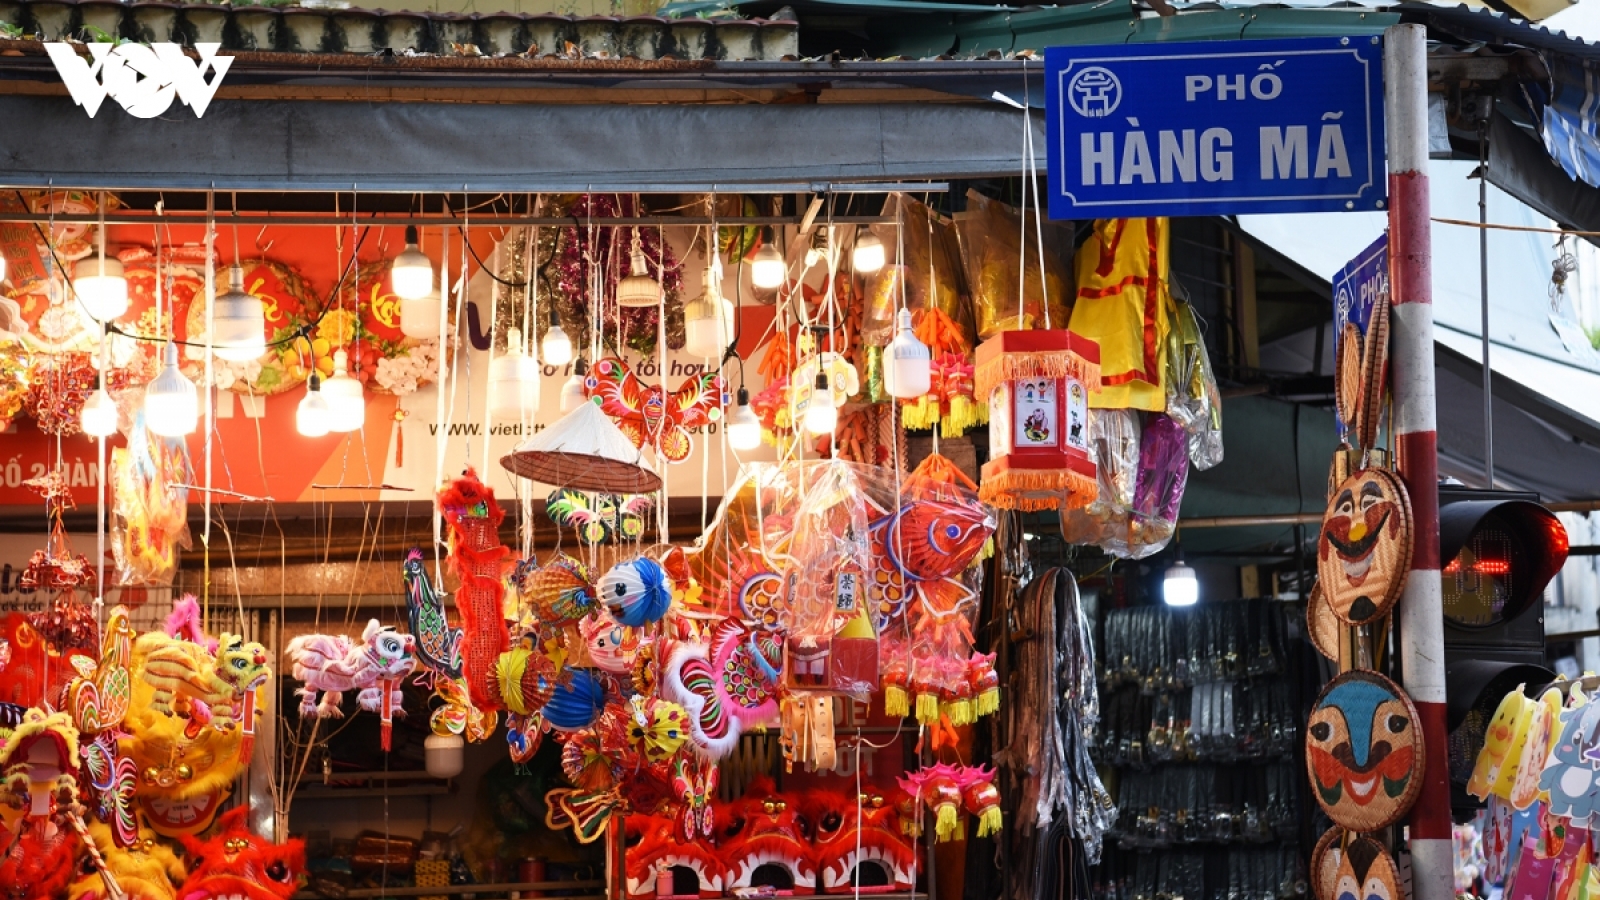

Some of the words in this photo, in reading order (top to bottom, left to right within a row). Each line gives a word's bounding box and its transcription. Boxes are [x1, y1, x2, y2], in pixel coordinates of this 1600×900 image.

[1185, 60, 1286, 101] PHỐ
[1081, 116, 1234, 185] HÀNG
[1260, 110, 1352, 180] MÃ
[54, 456, 114, 488] HÀN
